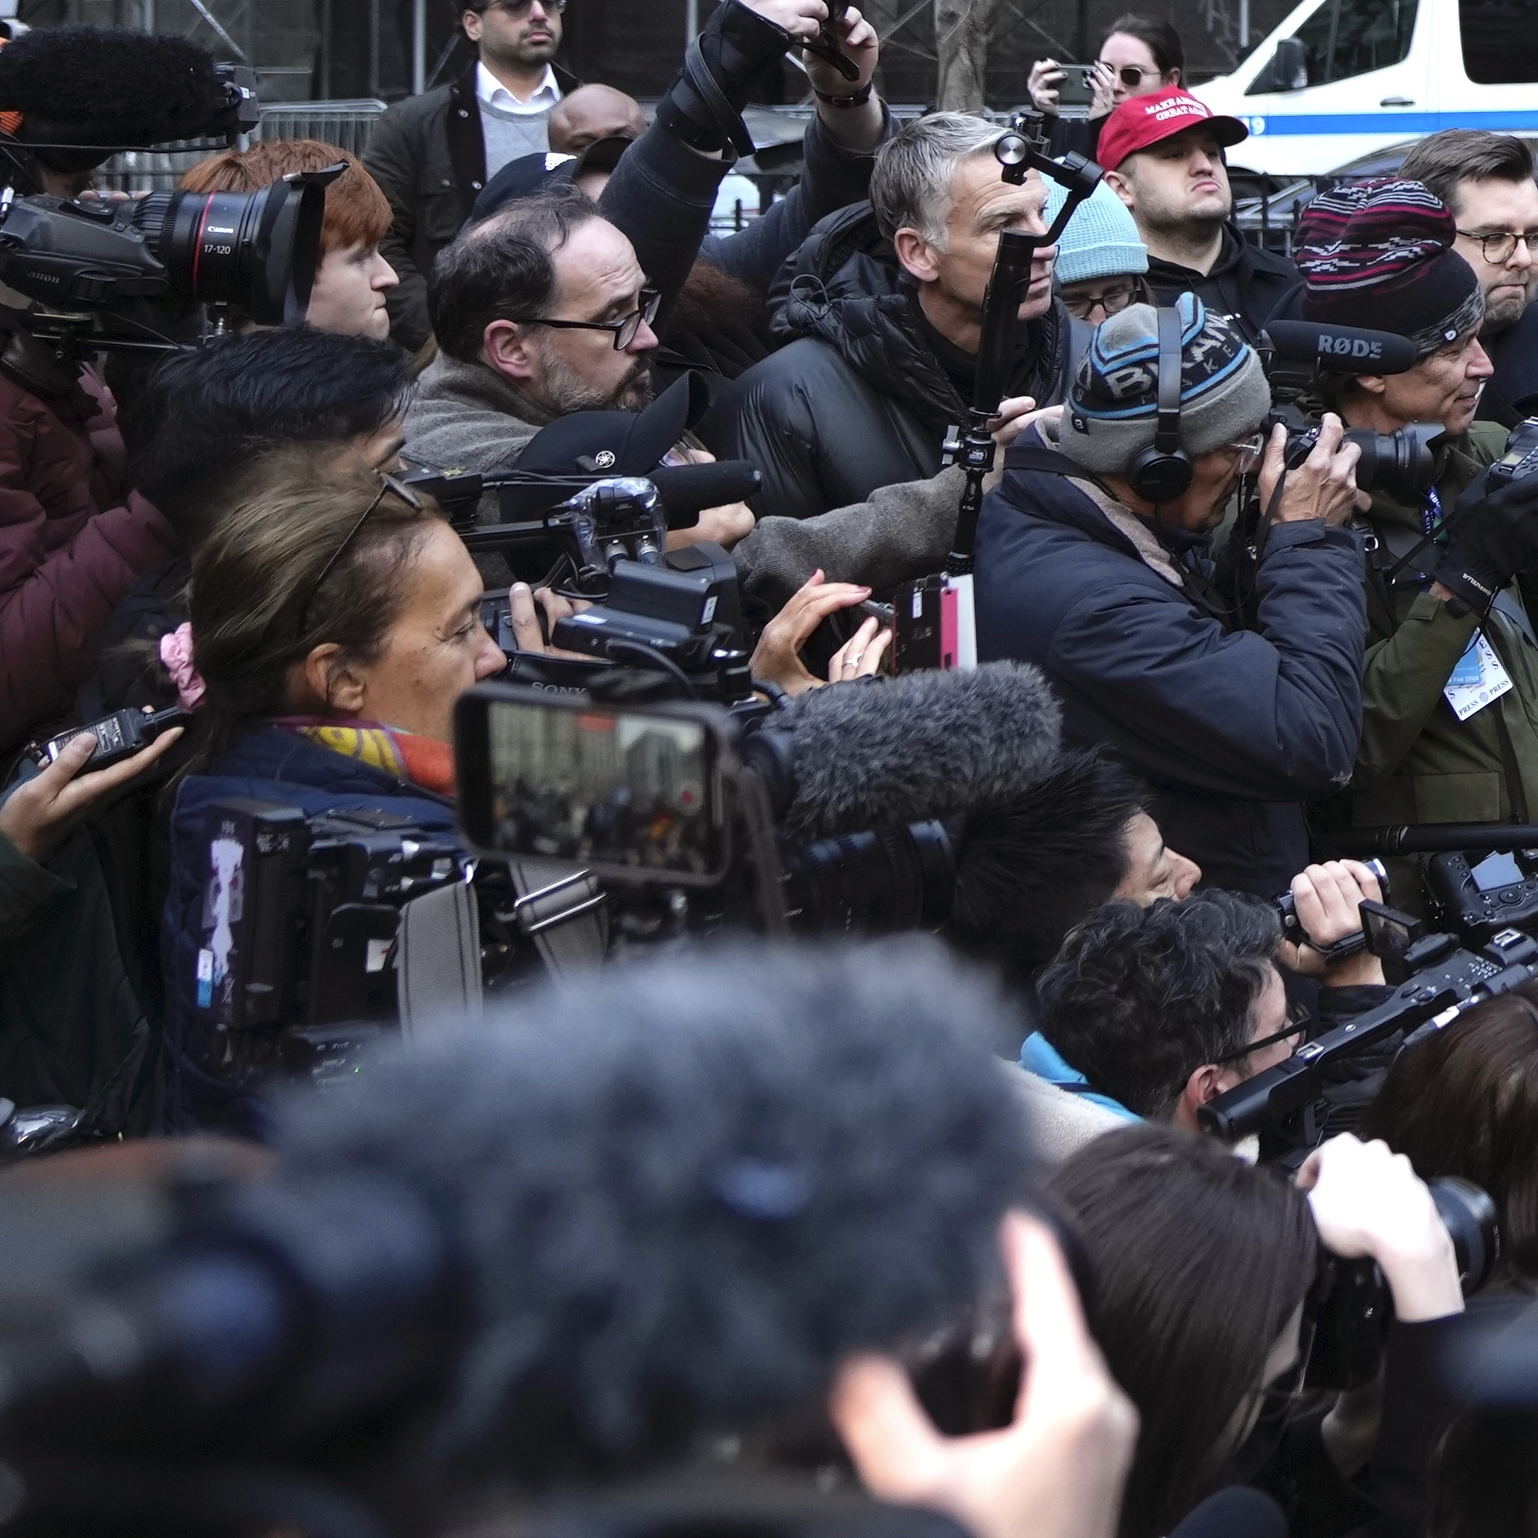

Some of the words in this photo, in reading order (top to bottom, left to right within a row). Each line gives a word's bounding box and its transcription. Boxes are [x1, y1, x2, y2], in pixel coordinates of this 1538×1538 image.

[207, 225, 234, 234] Canon
[203, 244, 231, 255] 17-120
[1458, 699, 1480, 717] PRESS
[1488, 677, 1511, 696] PRESS
